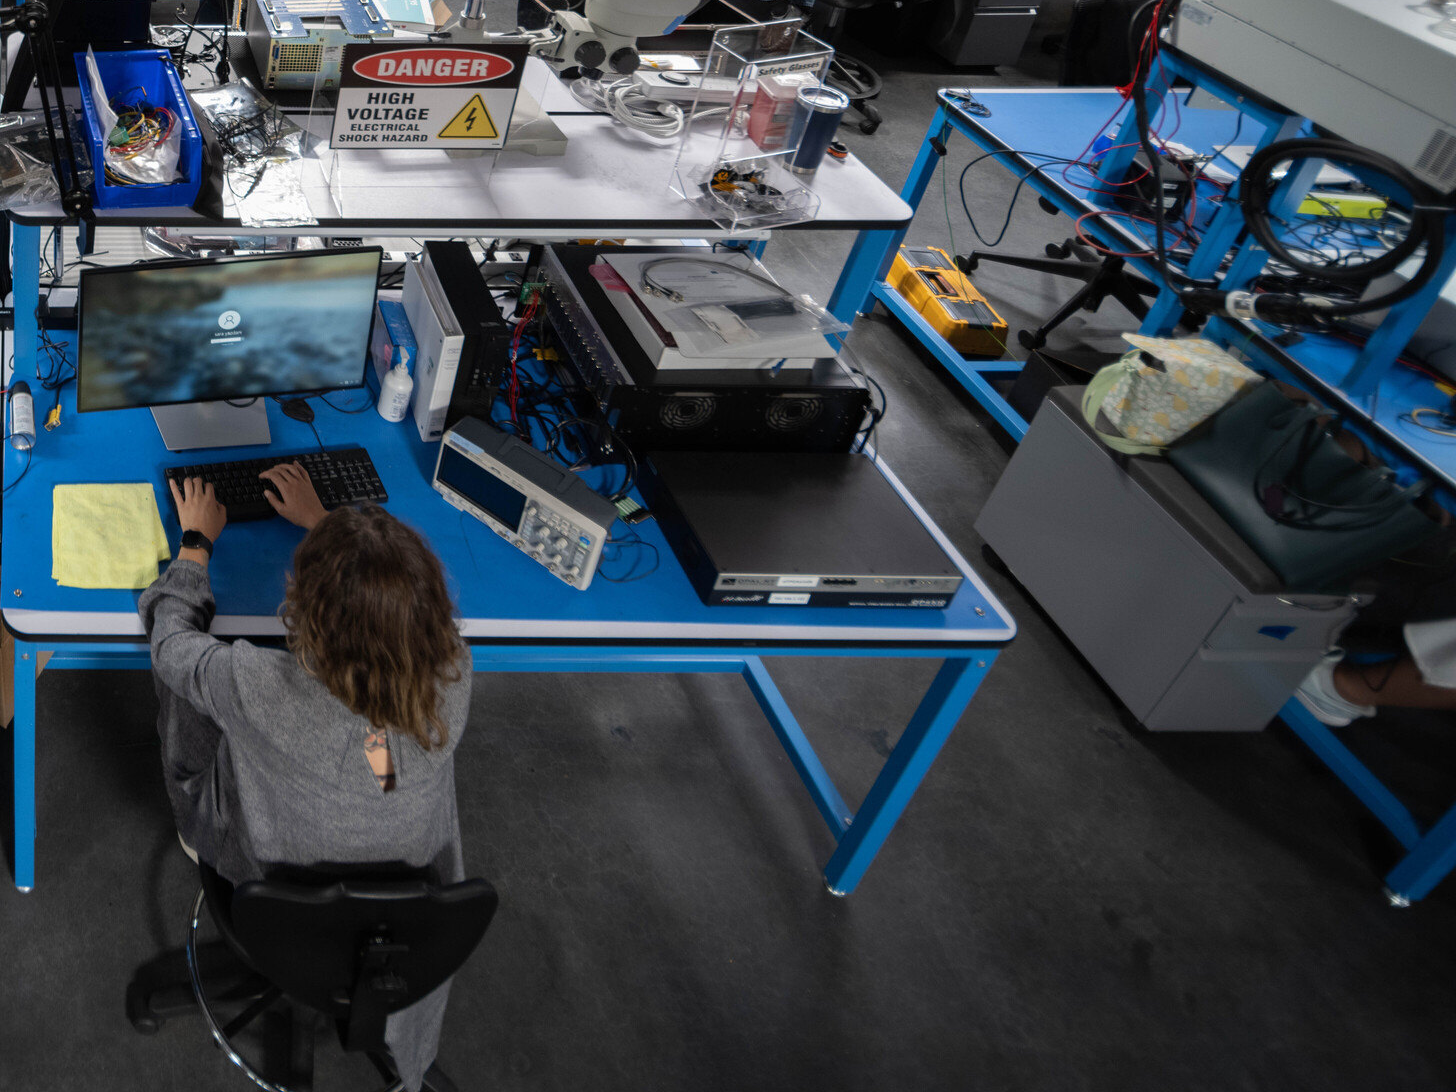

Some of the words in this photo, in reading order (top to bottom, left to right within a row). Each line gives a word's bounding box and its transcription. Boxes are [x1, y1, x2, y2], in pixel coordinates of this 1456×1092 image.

[377, 58, 490, 77] DANGER
[758, 67, 786, 77] Safety
[789, 61, 821, 72] Glasses
[367, 92, 415, 105] HIGH
[347, 108, 430, 120] VOLTAGE
[350, 123, 420, 132] ELECTRICAL
[338, 134, 378, 143] SHOCK
[381, 134, 429, 142] HAZARD
